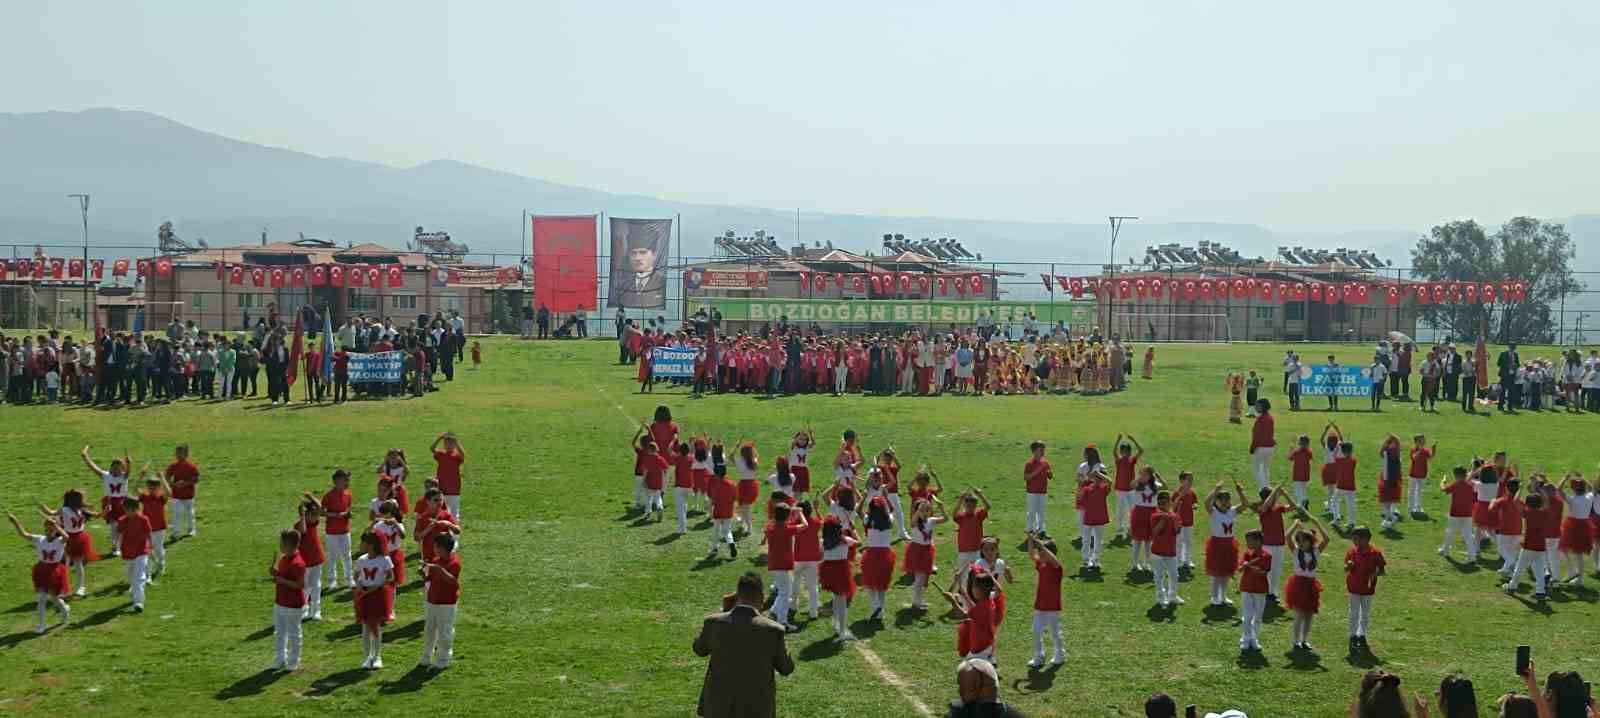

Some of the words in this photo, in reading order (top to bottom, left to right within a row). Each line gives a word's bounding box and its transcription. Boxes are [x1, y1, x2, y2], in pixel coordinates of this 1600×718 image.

[750, 301, 885, 320] BOZDOĞAN
[894, 302, 1036, 321] BELEDİYESİ
[1315, 374, 1356, 384] FATİH
[1302, 383, 1369, 395] İLKOKULU
